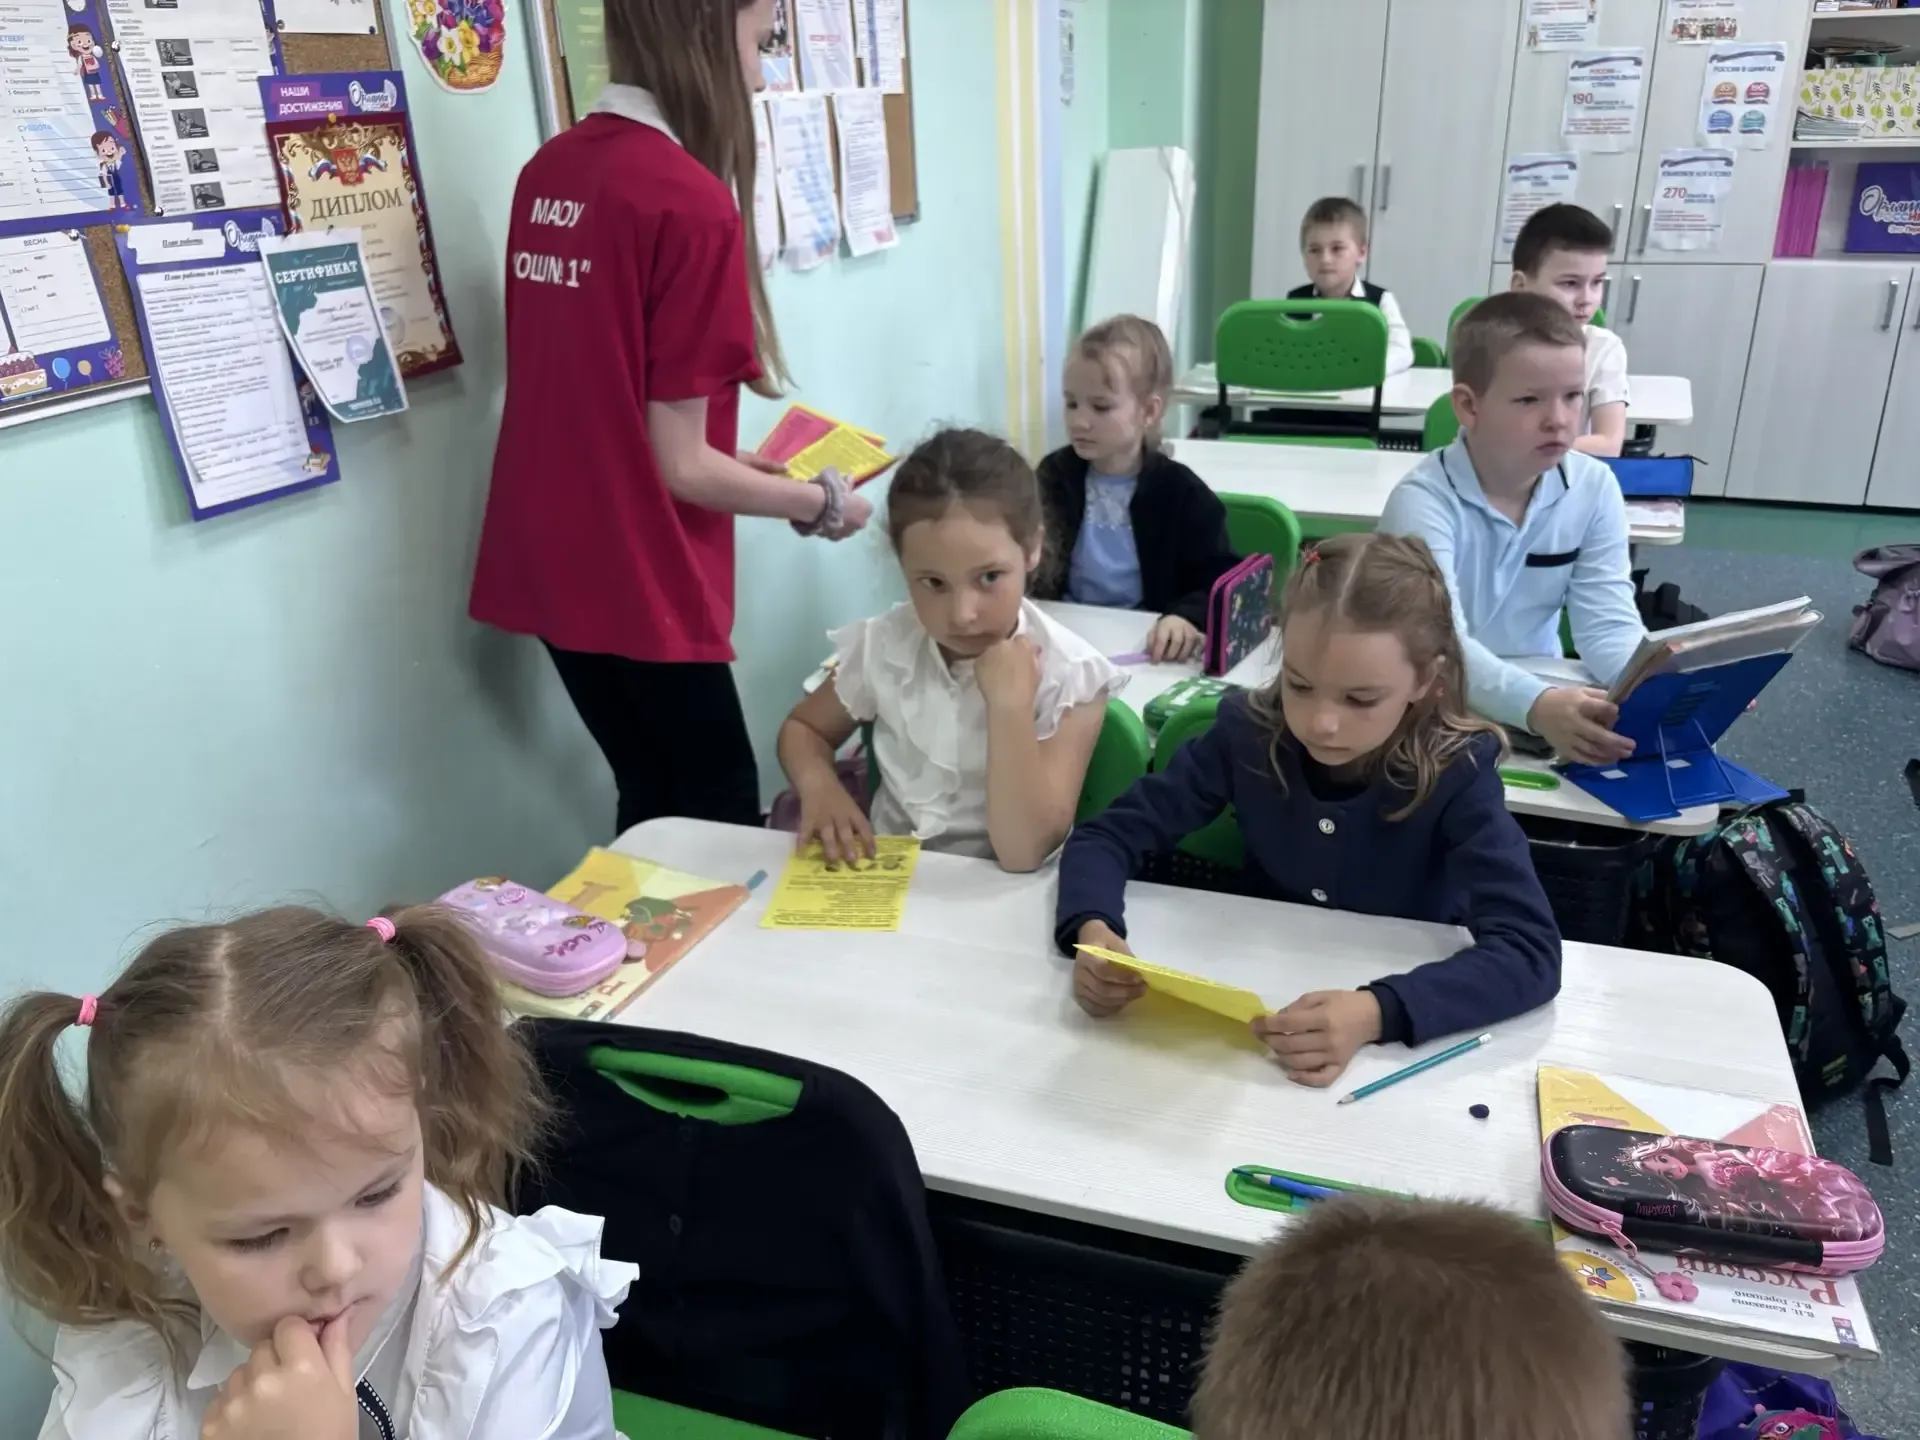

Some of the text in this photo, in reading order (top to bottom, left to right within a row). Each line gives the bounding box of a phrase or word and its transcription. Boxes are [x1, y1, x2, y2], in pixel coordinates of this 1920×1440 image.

[280, 86, 310, 97] НАШИ
[1572, 93, 1593, 104] 190
[279, 100, 344, 115] ДОСТИЖЕНИЯ
[1662, 187, 1687, 198] 270
[310, 188, 404, 221] ДИПЛОМ
[530, 197, 585, 228] МАОУ
[23, 238, 48, 247] ВЕСНА
[275, 260, 359, 285] СЕРТИФИКАТ
[1675, 1254, 1846, 1308] Русский
[1731, 1298, 1787, 1314] Канакина
[1734, 1290, 1788, 1306] Горецкий
